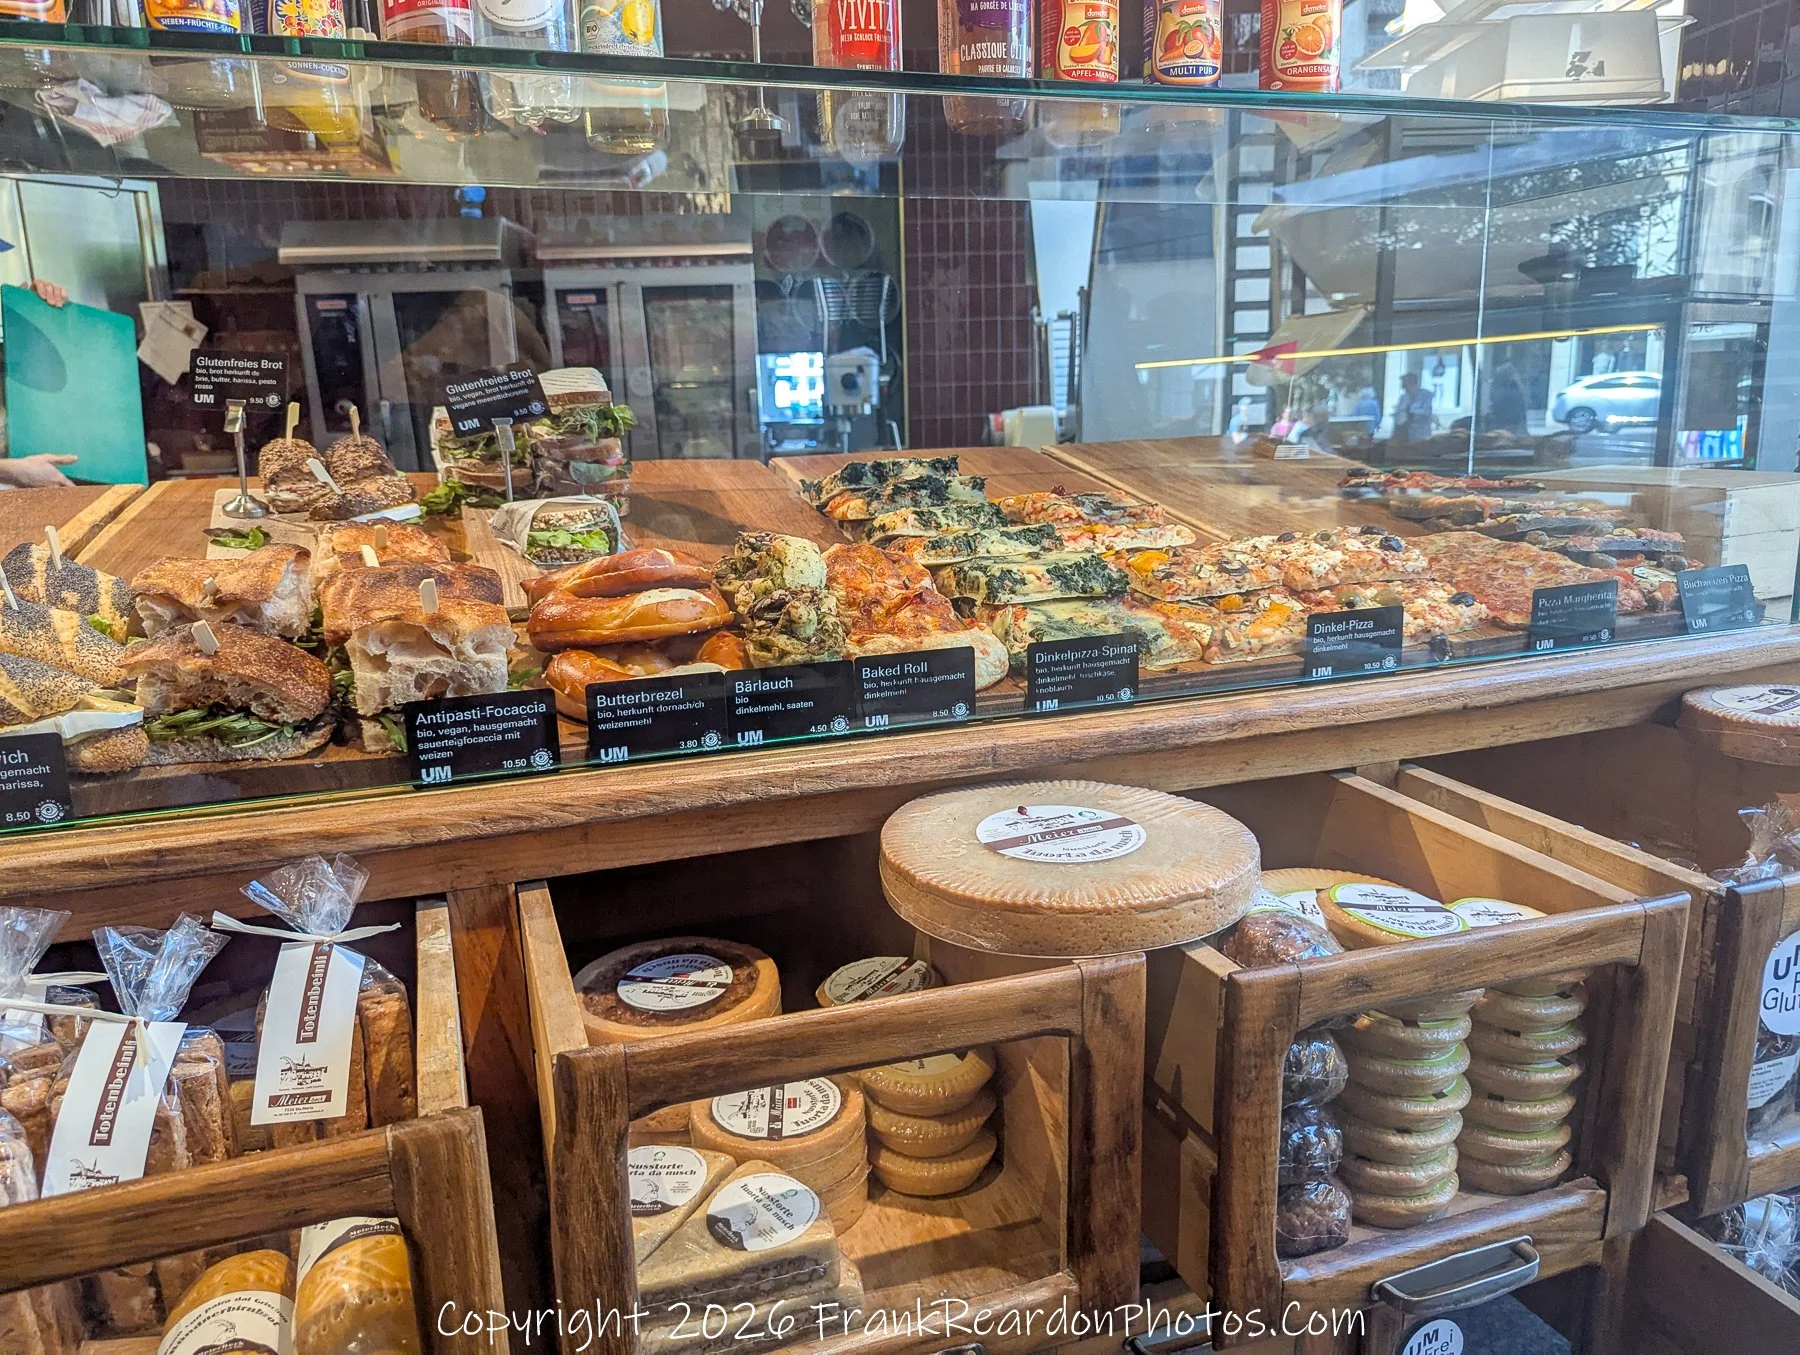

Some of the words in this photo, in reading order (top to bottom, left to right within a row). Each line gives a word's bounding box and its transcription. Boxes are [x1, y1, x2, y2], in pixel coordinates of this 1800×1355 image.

[1182, 5, 1205, 14] demeter
[1302, 4, 1327, 13] demeter
[160, 18, 234, 34] SIEBEN-FRÜCHTE-SAFT
[960, 42, 1008, 62] CLASSIQUE
[1071, 69, 1115, 81] APFEL-MANGO
[1169, 66, 1196, 77] MULTI
[1198, 66, 1213, 75] PUR
[196, 356, 259, 369] Glutenfreies
[261, 359, 283, 370] Brot
[210, 376, 232, 384] butter,
[232, 377, 258, 385] harissa,
[445, 374, 510, 395] Glutenfreies
[509, 368, 534, 381] Brot
[194, 393, 215, 404] UM
[448, 395, 463, 403] bio,
[462, 390, 486, 401] vegan,
[485, 387, 500, 395] brot
[500, 381, 527, 392] herkunft
[452, 400, 477, 411] vegane
[457, 418, 481, 431] UM
[1729, 574, 1749, 583] Pizza
[1538, 598, 1561, 608] Pizza
[1314, 619, 1374, 635] Dinkel-Pizza
[1691, 618, 1708, 629] UM
[1326, 633, 1353, 642] herkunft
[1353, 629, 1396, 639] hausgemacht
[1312, 643, 1348, 653] dinkelmehl
[1536, 639, 1554, 650] UM
[1035, 643, 1138, 664] Dinkelpizza-Spinat
[862, 664, 900, 679] Baked
[904, 661, 928, 675] Roll
[1051, 663, 1081, 673] herkunft
[1082, 657, 1131, 669] hausgemacht
[1364, 661, 1381, 670] 10.50
[1312, 666, 1333, 678] UM
[735, 676, 794, 694] Bärlauch
[863, 681, 879, 689] bio,
[880, 678, 912, 688] herkunft
[914, 672, 966, 684] hausgemacht
[863, 689, 907, 700] dinkelmehl
[1035, 684, 1073, 694] knoblauch
[596, 687, 684, 708] Butterbrezel
[735, 696, 749, 705] bio
[1096, 693, 1115, 702] 10.50
[597, 709, 615, 719] bio,
[616, 705, 655, 717] herkunft
[656, 700, 705, 713] dornach/ch
[735, 702, 785, 715] dinkelmehl,
[786, 700, 814, 710] saaten
[1035, 699, 1059, 712] UM
[415, 701, 547, 726] Antipasti-Focaccia
[932, 709, 949, 718] 8.50
[597, 717, 653, 731] weizenmehl
[865, 714, 889, 728] UM
[416, 729, 437, 739] bio,
[437, 726, 473, 737] vegan,
[473, 718, 539, 731] hausgemacht
[809, 724, 828, 733] 4.50
[417, 732, 503, 751] sauerteigfocaccia
[504, 730, 521, 741] mit
[737, 729, 763, 745] UM
[679, 739, 698, 749] 3.80
[419, 750, 454, 761] weizen
[600, 746, 629, 762] UM
[502, 758, 527, 769] 10.50
[421, 765, 452, 783] UM
[5, 811, 31, 822] 8.50
[1019, 830, 1077, 846] Meier
[299, 955, 329, 1042] Totenbeinli
[92, 1040, 138, 1144] Totenbeinli
[270, 1094, 310, 1107] Meier
[740, 1183, 763, 1204] Tuorta
[762, 1202, 774, 1212] da
[772, 1211, 796, 1232] nusch
[755, 1186, 794, 1218] Nusstorte
